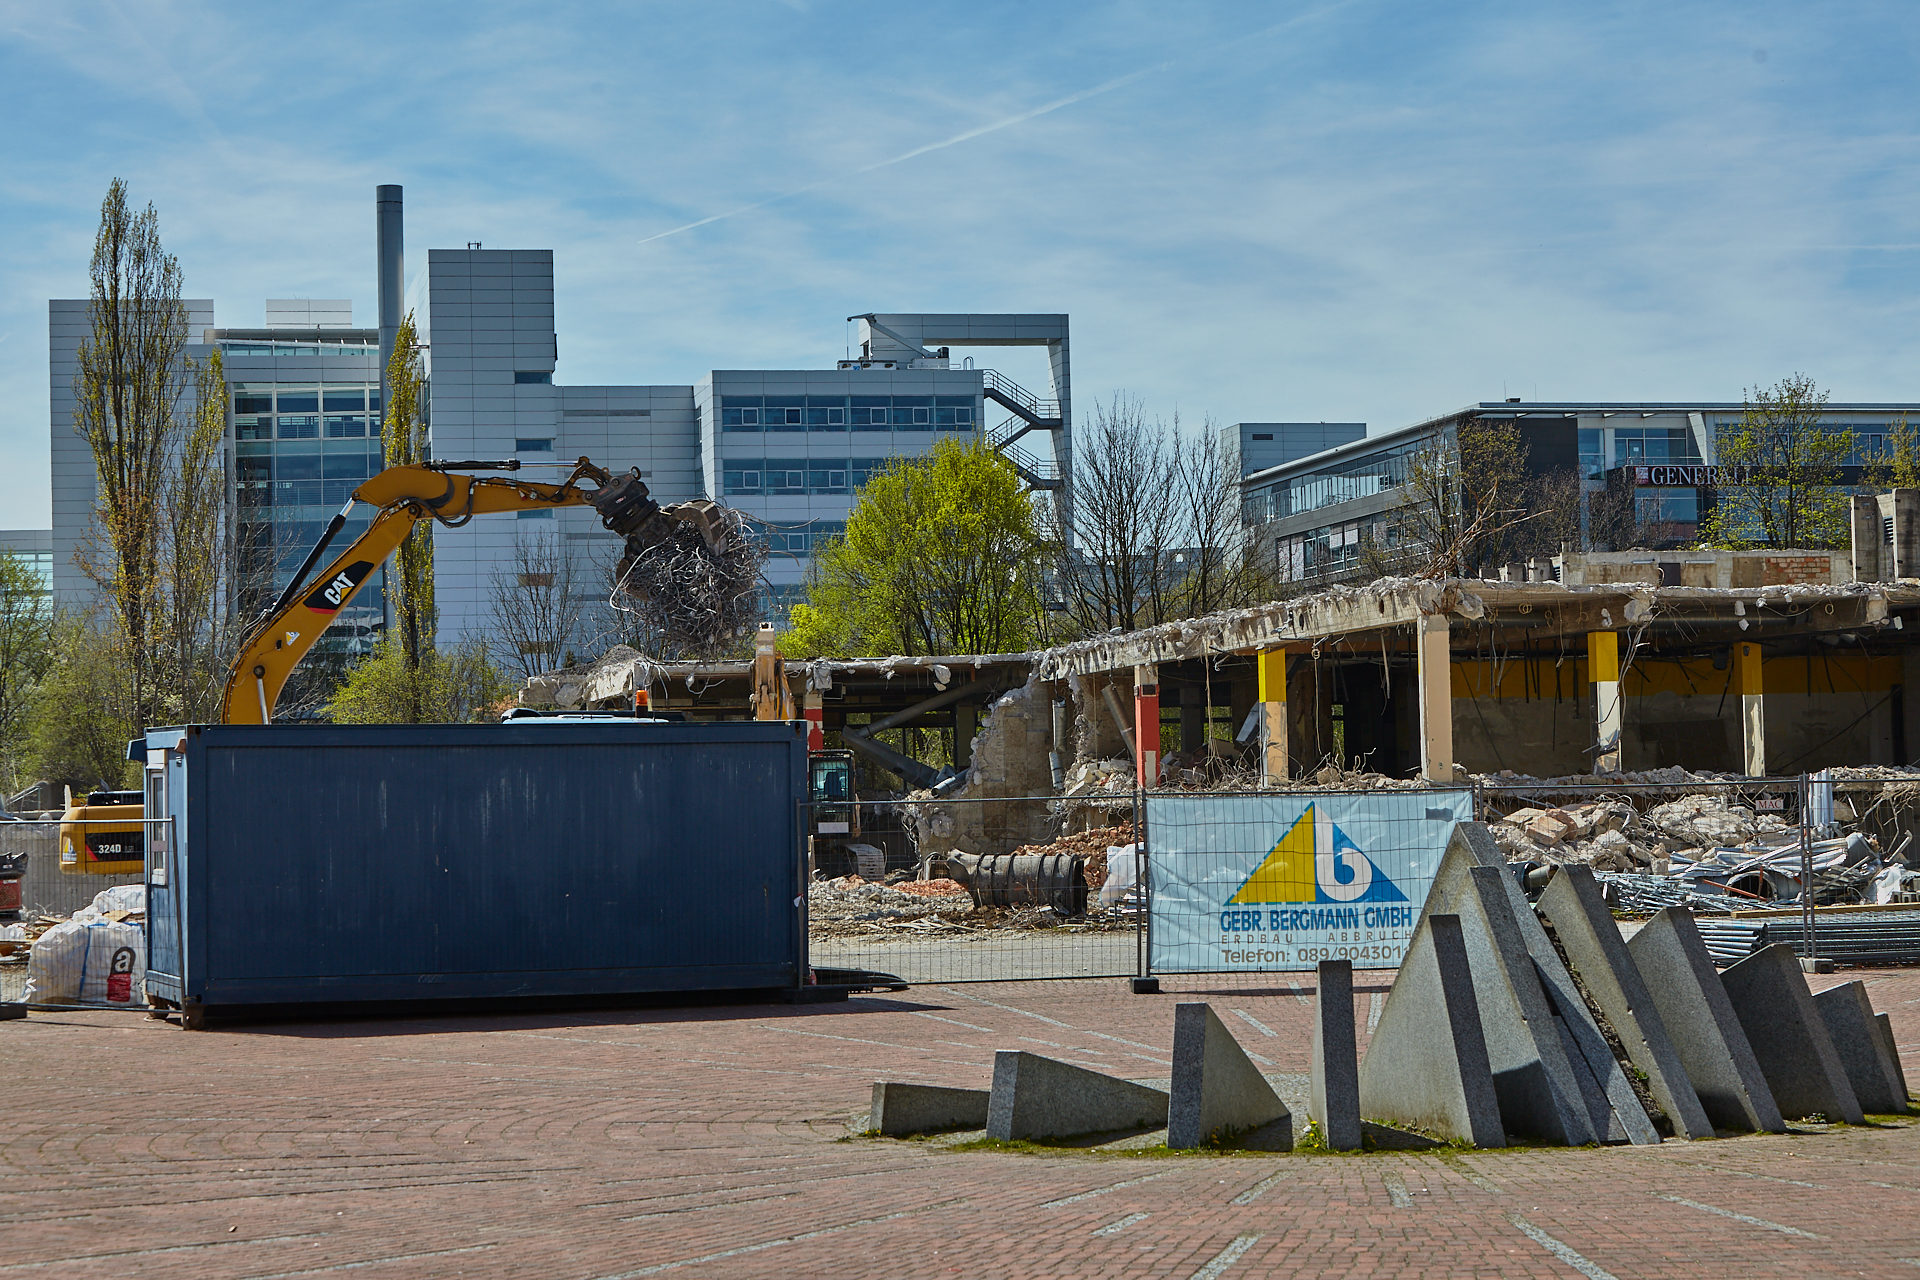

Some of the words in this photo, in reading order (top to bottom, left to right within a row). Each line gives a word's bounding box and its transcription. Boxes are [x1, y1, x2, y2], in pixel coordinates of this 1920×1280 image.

[324, 571, 355, 605] CAT
[1758, 800, 1781, 809] MAC
[98, 843, 122, 854] 324D
[1221, 910, 1266, 932] GEBR.
[1270, 908, 1358, 931] BERGMANN
[1364, 906, 1412, 929] GMBH
[1221, 934, 1293, 944] ERDBAU
[1328, 930, 1412, 942] ABBRUCH
[1221, 948, 1291, 963] Telefon:
